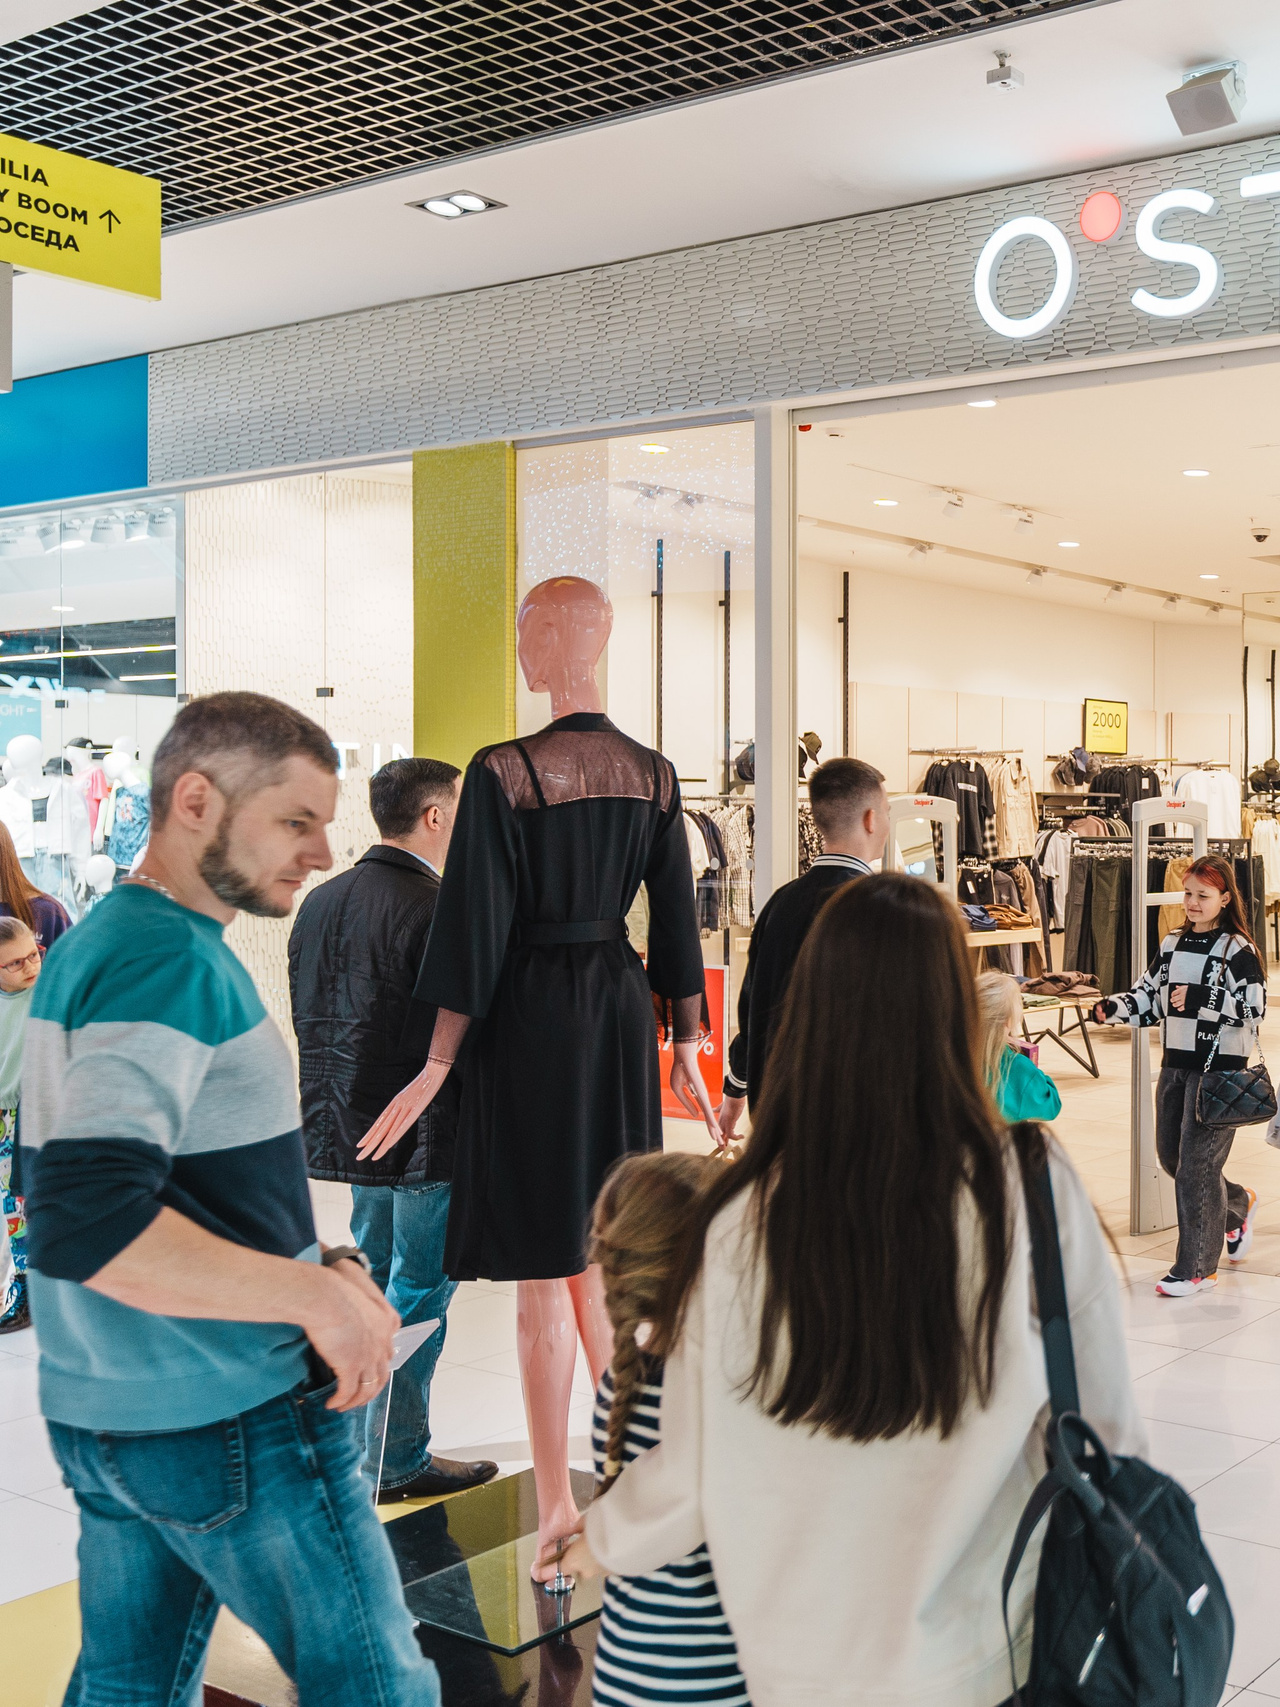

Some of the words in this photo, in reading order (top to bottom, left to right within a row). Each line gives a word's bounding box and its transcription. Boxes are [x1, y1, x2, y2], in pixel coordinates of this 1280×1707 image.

[0, 157, 49, 188] ILIA
[18, 192, 88, 225] BOOM
[0, 216, 80, 252] ОСЕДА
[1092, 711, 1122, 729] 2000
[1207, 985, 1219, 1010] PEACE
